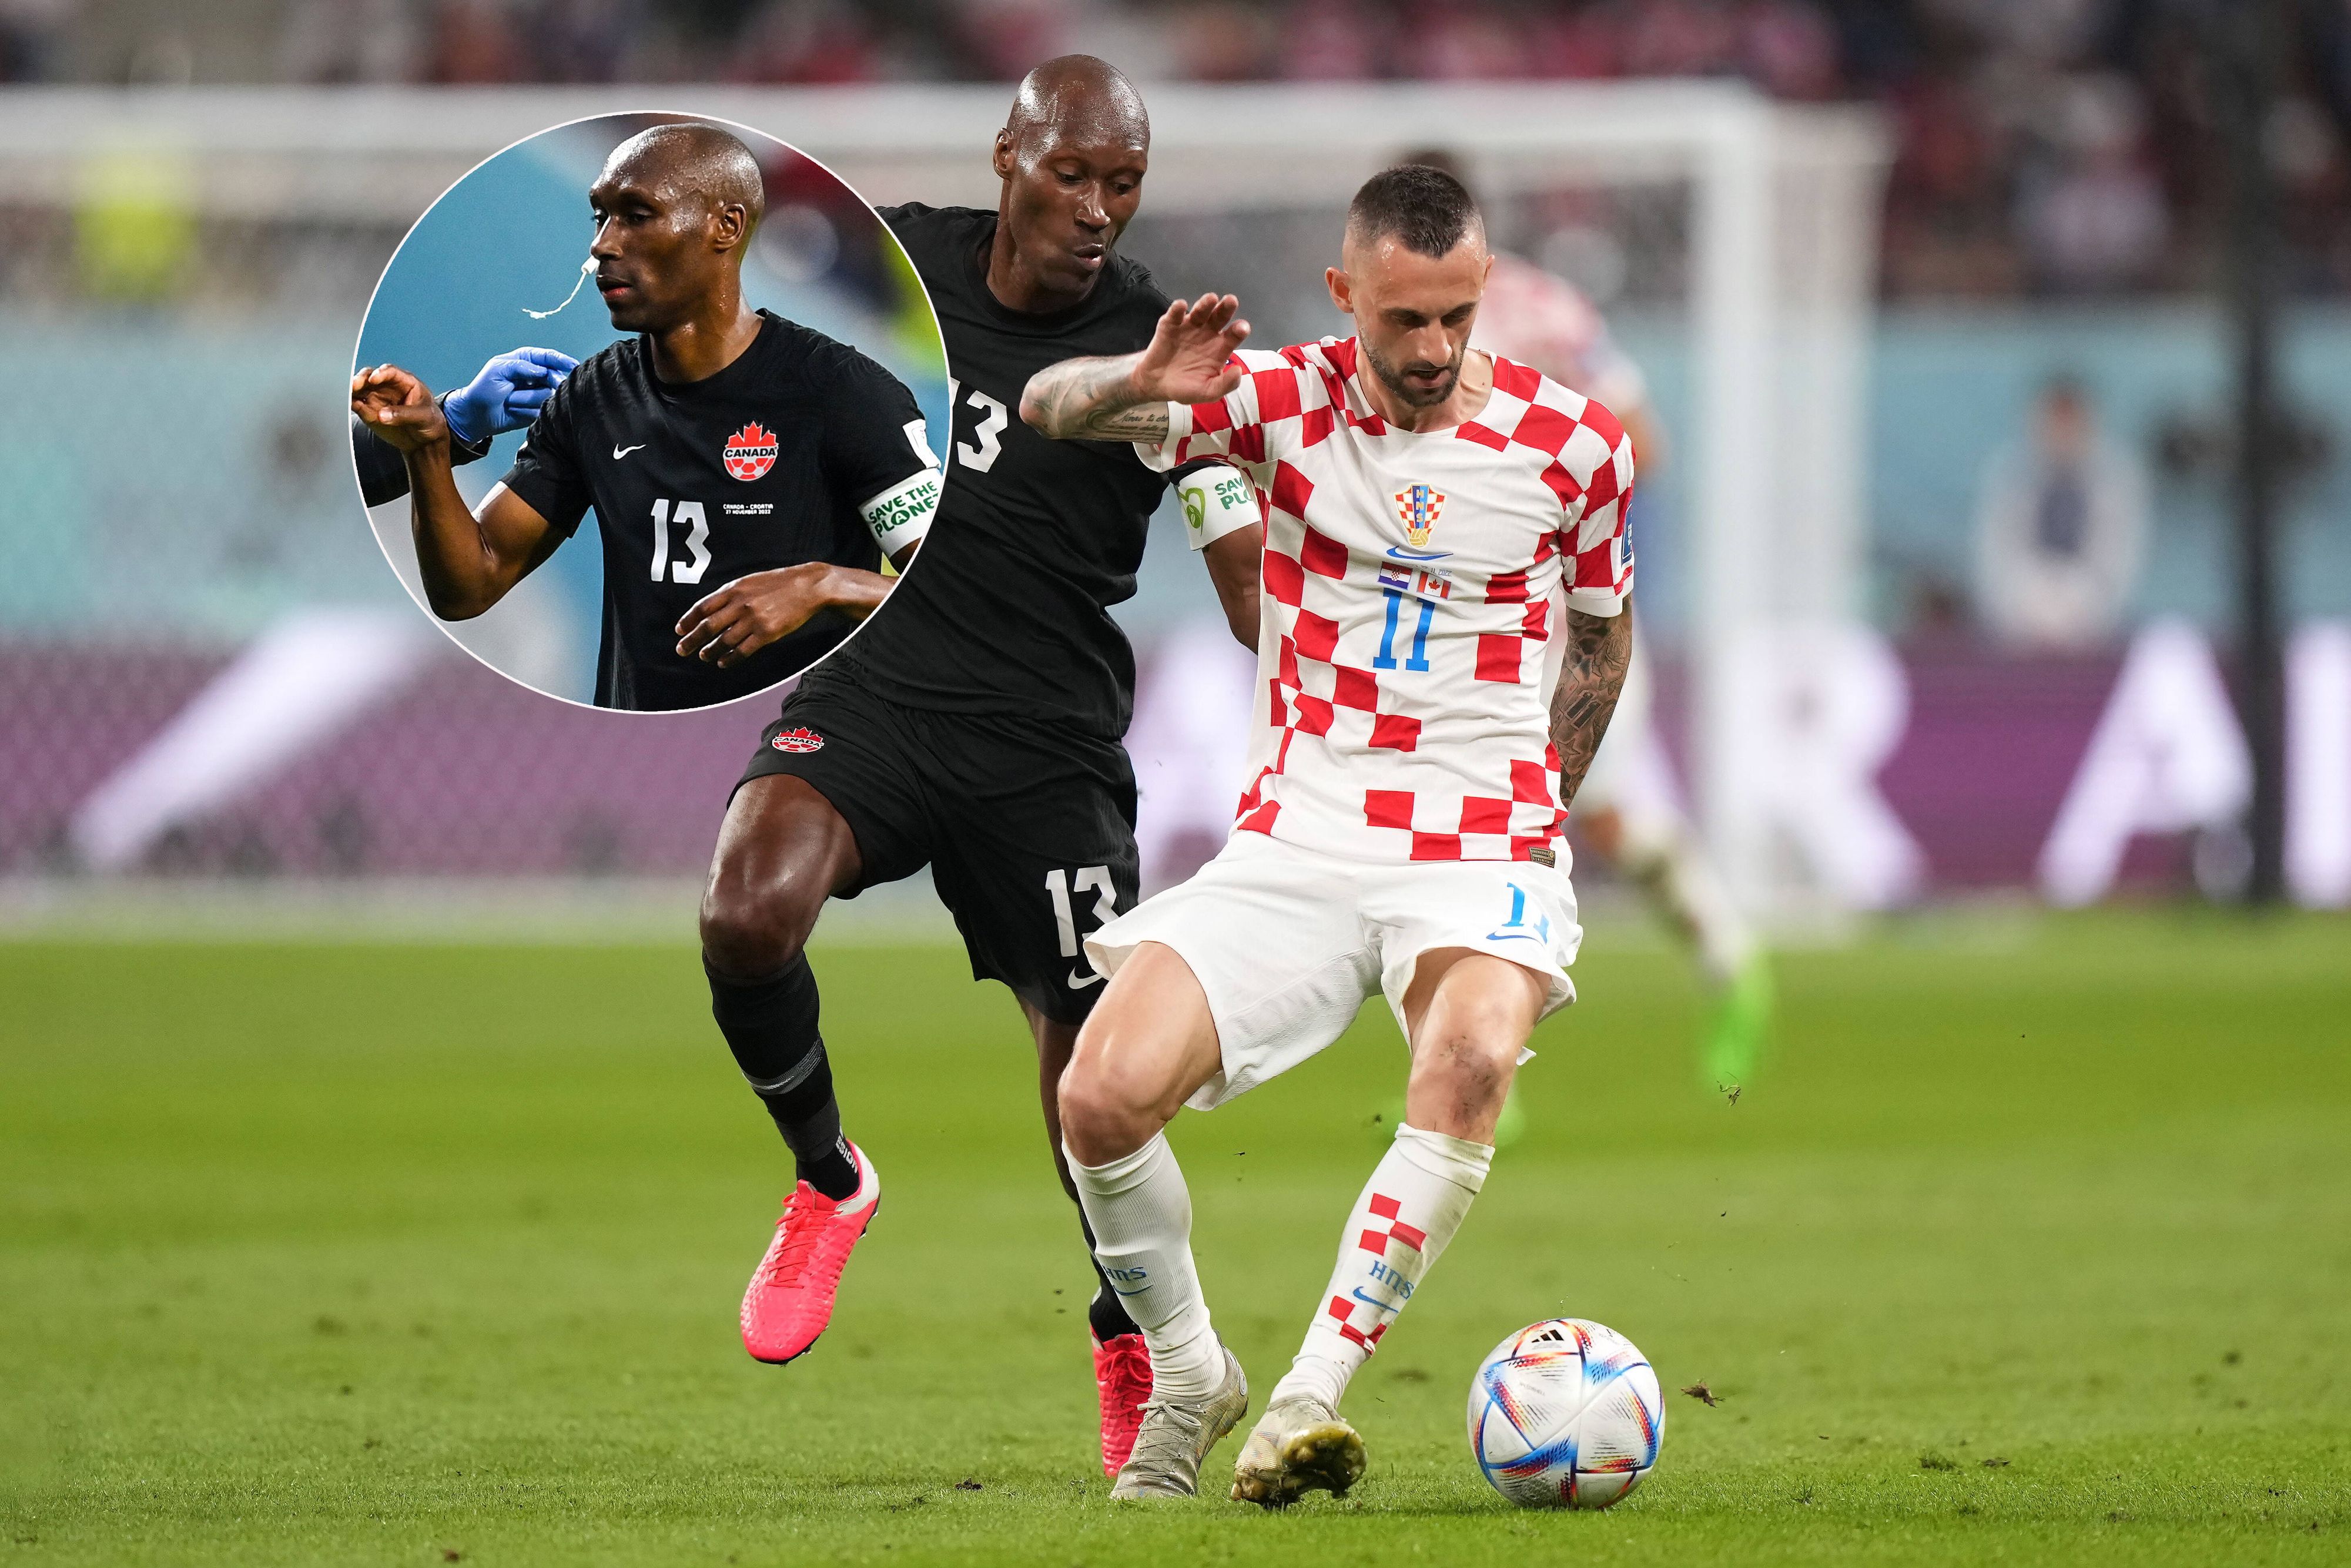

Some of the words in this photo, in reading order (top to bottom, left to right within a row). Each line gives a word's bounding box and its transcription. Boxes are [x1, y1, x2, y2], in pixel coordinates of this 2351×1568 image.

[725, 448, 776, 458] CANADA
[869, 495, 906, 524] SAVE
[906, 481, 937, 500] THE
[650, 498, 712, 584] 13
[1373, 588, 1436, 672] 11
[774, 737, 820, 748] CANADA
[1045, 865, 1120, 957] 13
